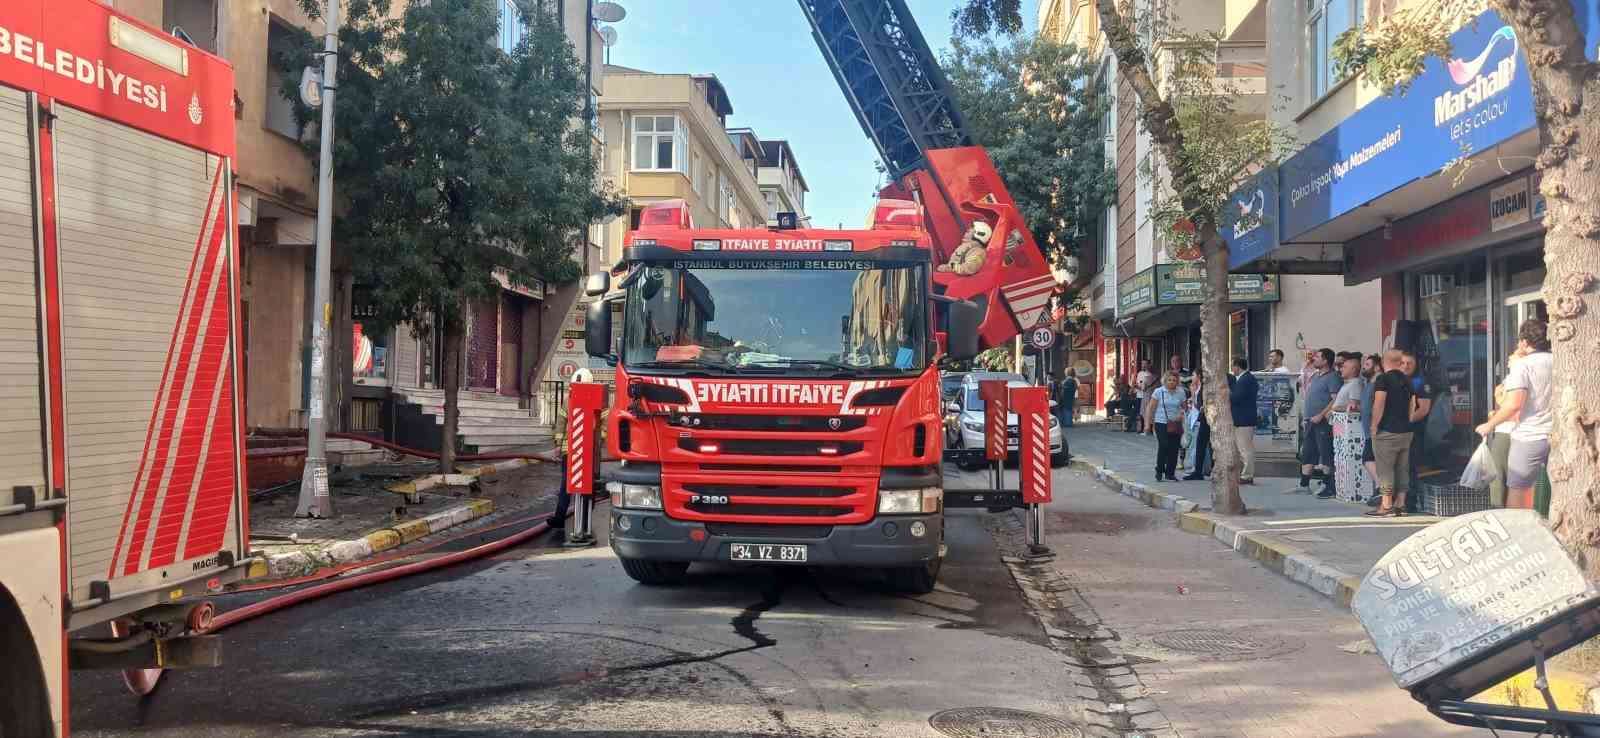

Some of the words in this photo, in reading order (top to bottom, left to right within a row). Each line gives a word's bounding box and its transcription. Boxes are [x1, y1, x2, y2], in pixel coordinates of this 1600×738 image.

[0, 26, 167, 113] BELEDİYESİ
[1434, 55, 1515, 128] Marshall
[1350, 124, 1401, 170] Malzemeleri
[1034, 328, 1051, 343] 30
[691, 495, 700, 503] P
[702, 496, 728, 504] 320
[738, 546, 751, 558] 34
[759, 546, 773, 559] VZ
[780, 546, 805, 559] 8371
[1369, 511, 1511, 601] SULTAN
